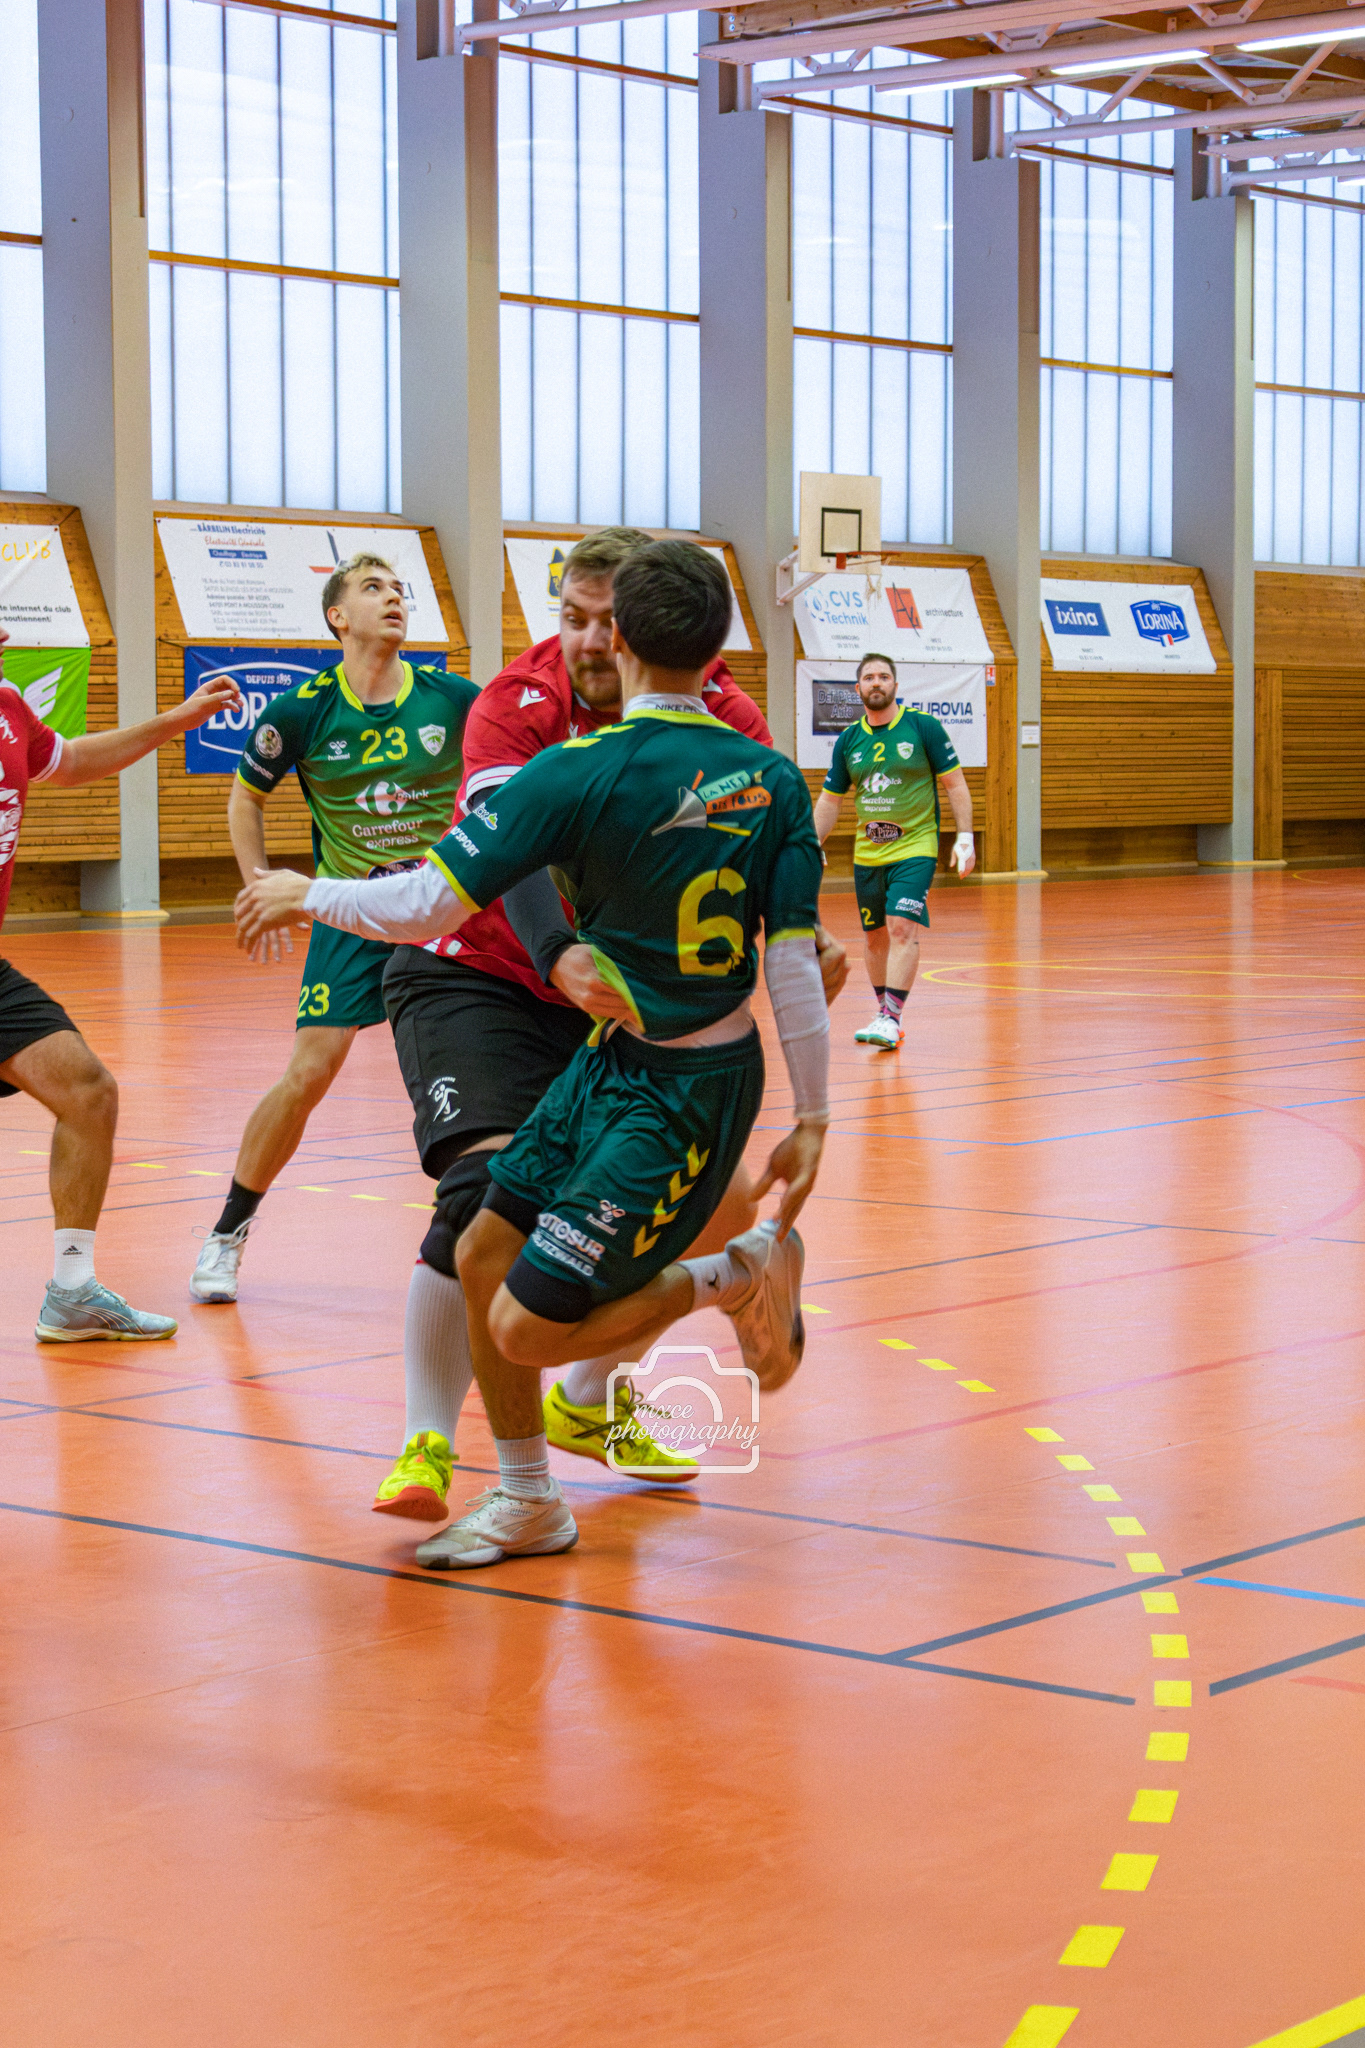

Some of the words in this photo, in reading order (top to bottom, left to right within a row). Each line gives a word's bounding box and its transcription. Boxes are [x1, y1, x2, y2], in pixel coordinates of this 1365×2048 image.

[1, 540, 51, 562] CLUB
[9, 604, 41, 613] internet
[43, 605, 53, 613] du
[54, 605, 72, 613] club
[829, 590, 863, 608] CVS
[824, 611, 869, 625] Technik
[1054, 606, 1099, 626] ixina
[1136, 609, 1185, 631] LORINA
[246, 674, 276, 685] DEPUIS
[276, 673, 293, 686] 1895
[656, 703, 683, 712] NIKE
[911, 702, 973, 716] EUROVIA
[360, 726, 409, 765] 23
[873, 742, 886, 763] 2
[327, 752, 351, 762] hummel
[702, 789, 719, 799] LA
[718, 775, 746, 794] NEF
[861, 796, 896, 805] Carrefour
[352, 819, 424, 839] Carrefour
[366, 834, 420, 850] express
[677, 866, 748, 977] 6
[861, 907, 876, 926] 2
[297, 982, 331, 1019] 23
